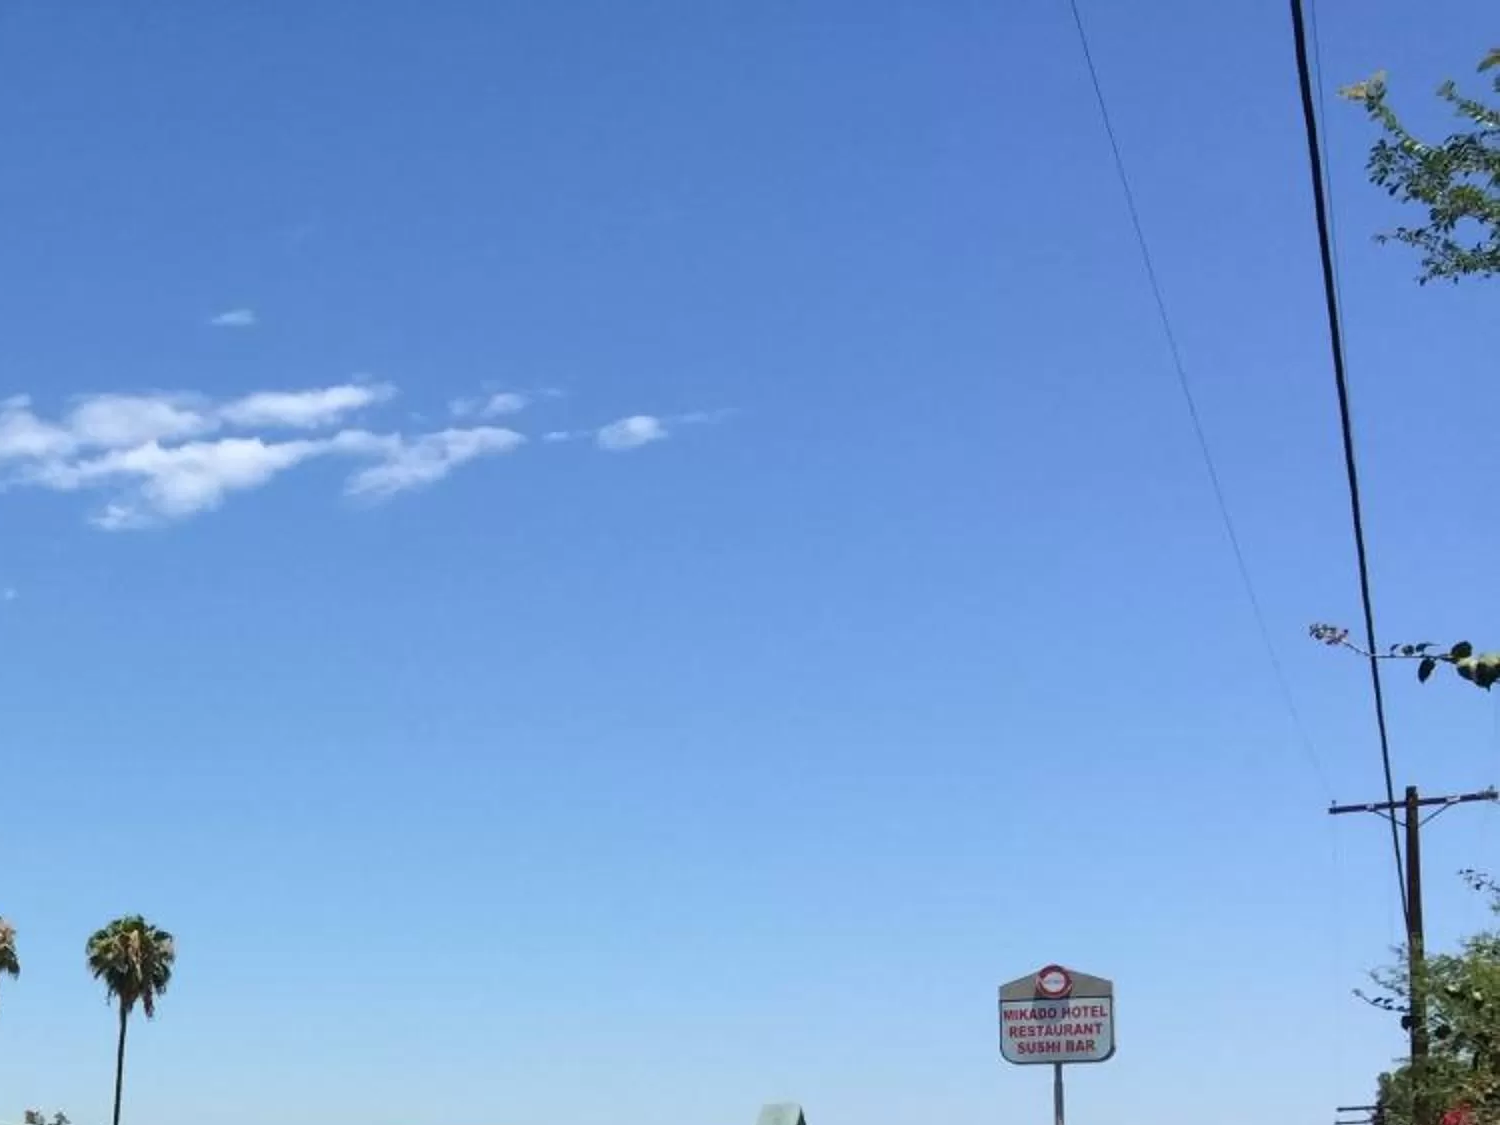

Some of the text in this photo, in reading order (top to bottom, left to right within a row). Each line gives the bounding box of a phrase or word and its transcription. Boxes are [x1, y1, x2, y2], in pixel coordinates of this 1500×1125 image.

[1003, 1006, 1108, 1020] MIKADO HOTEL
[1009, 1023, 1102, 1038] RESTAURANT
[1017, 1039, 1095, 1054] SUSHI BAR
